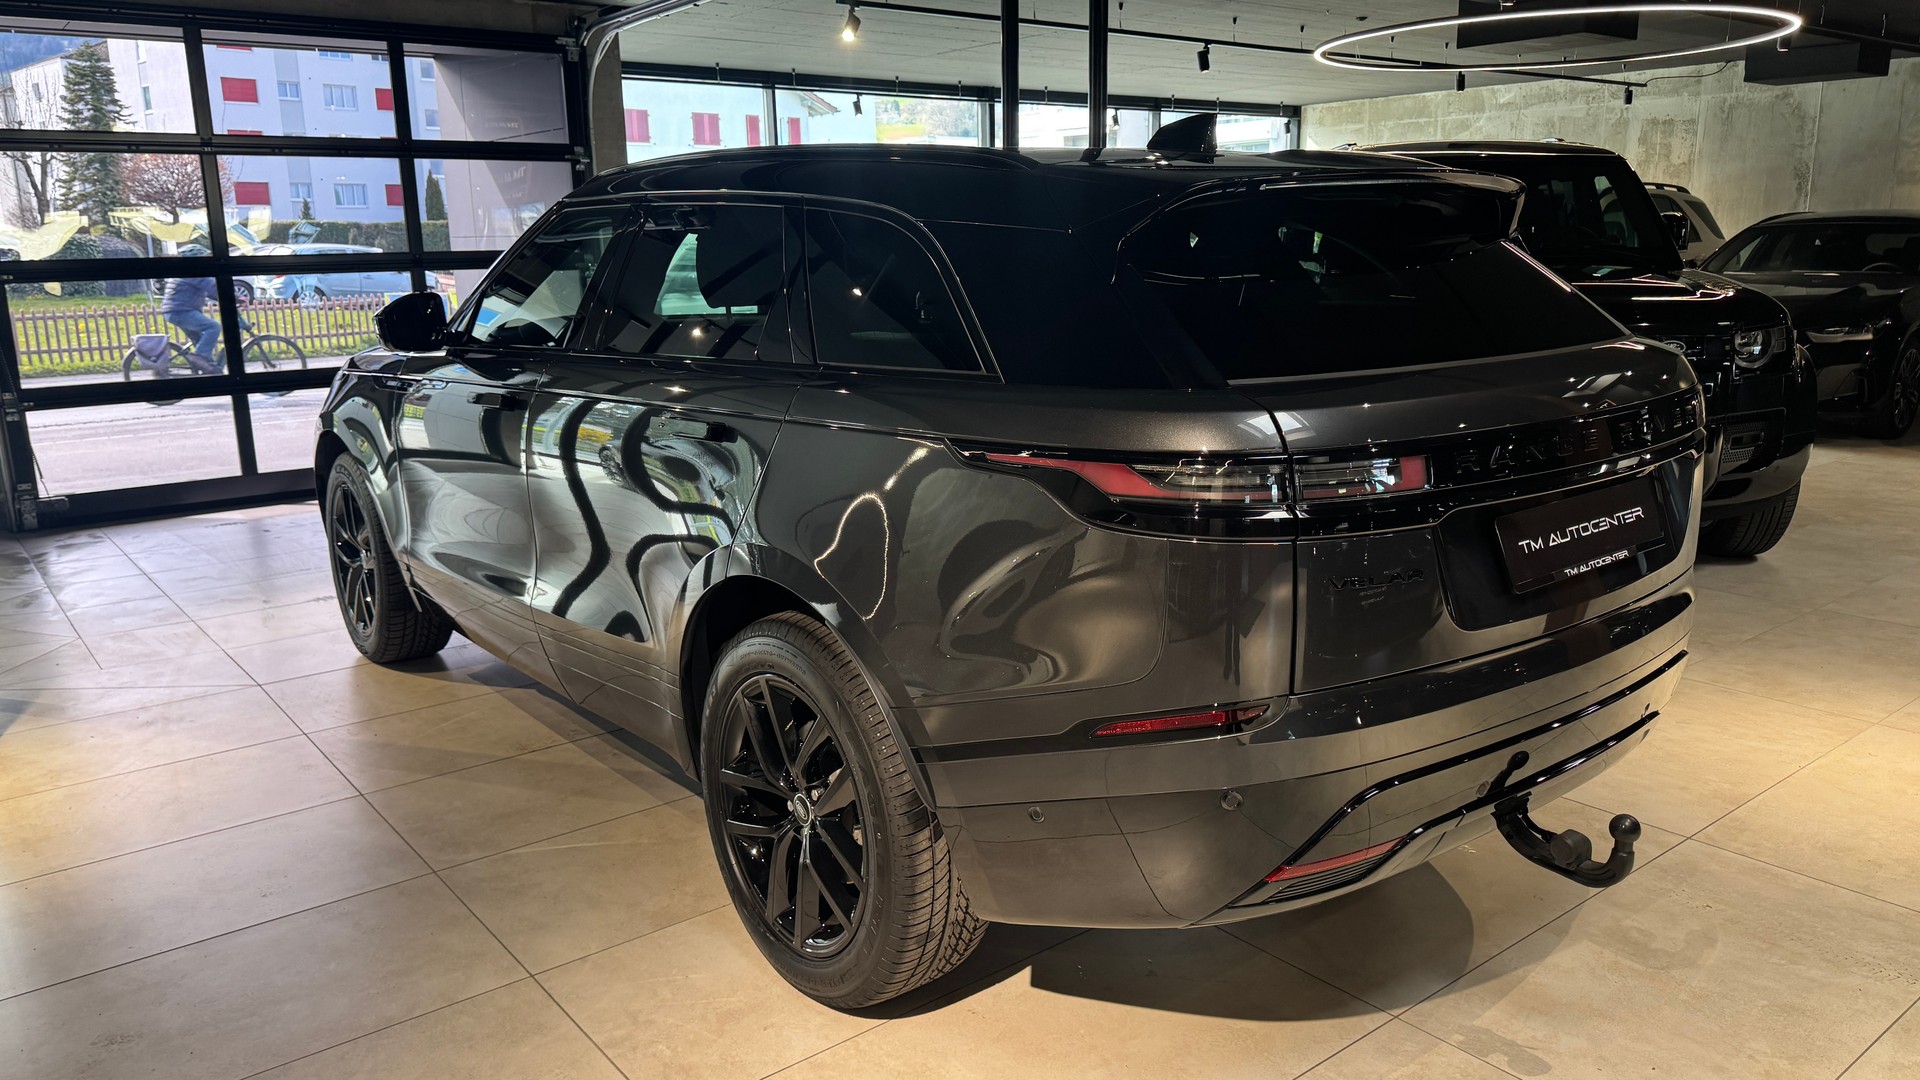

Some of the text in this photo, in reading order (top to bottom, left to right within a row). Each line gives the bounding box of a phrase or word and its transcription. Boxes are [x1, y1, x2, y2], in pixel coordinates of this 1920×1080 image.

[1456, 401, 1699, 474] RANGE ROVER
[1518, 506, 1645, 554] TM AUTOCENTER
[1329, 568, 1424, 592] VELAR
[1564, 550, 1629, 577] TM AUTOCENTER
